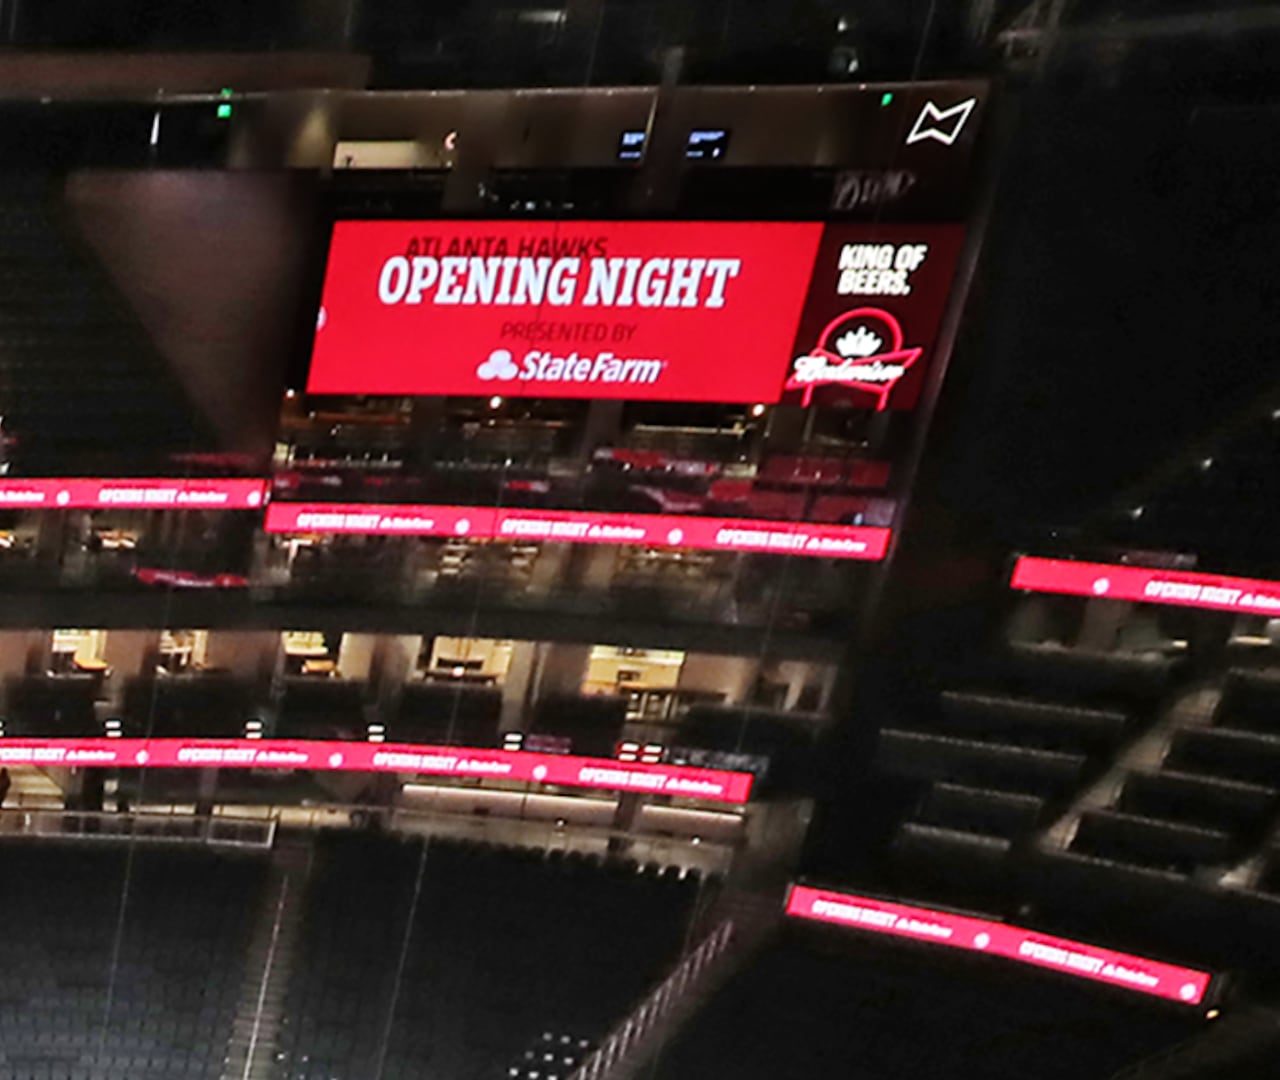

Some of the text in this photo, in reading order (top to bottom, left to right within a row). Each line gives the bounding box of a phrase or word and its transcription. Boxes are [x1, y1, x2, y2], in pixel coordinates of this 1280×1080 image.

[837, 244, 928, 271] KING OF
[378, 256, 740, 308] OPENING NIGHT
[500, 320, 637, 343] PRESENTED BY
